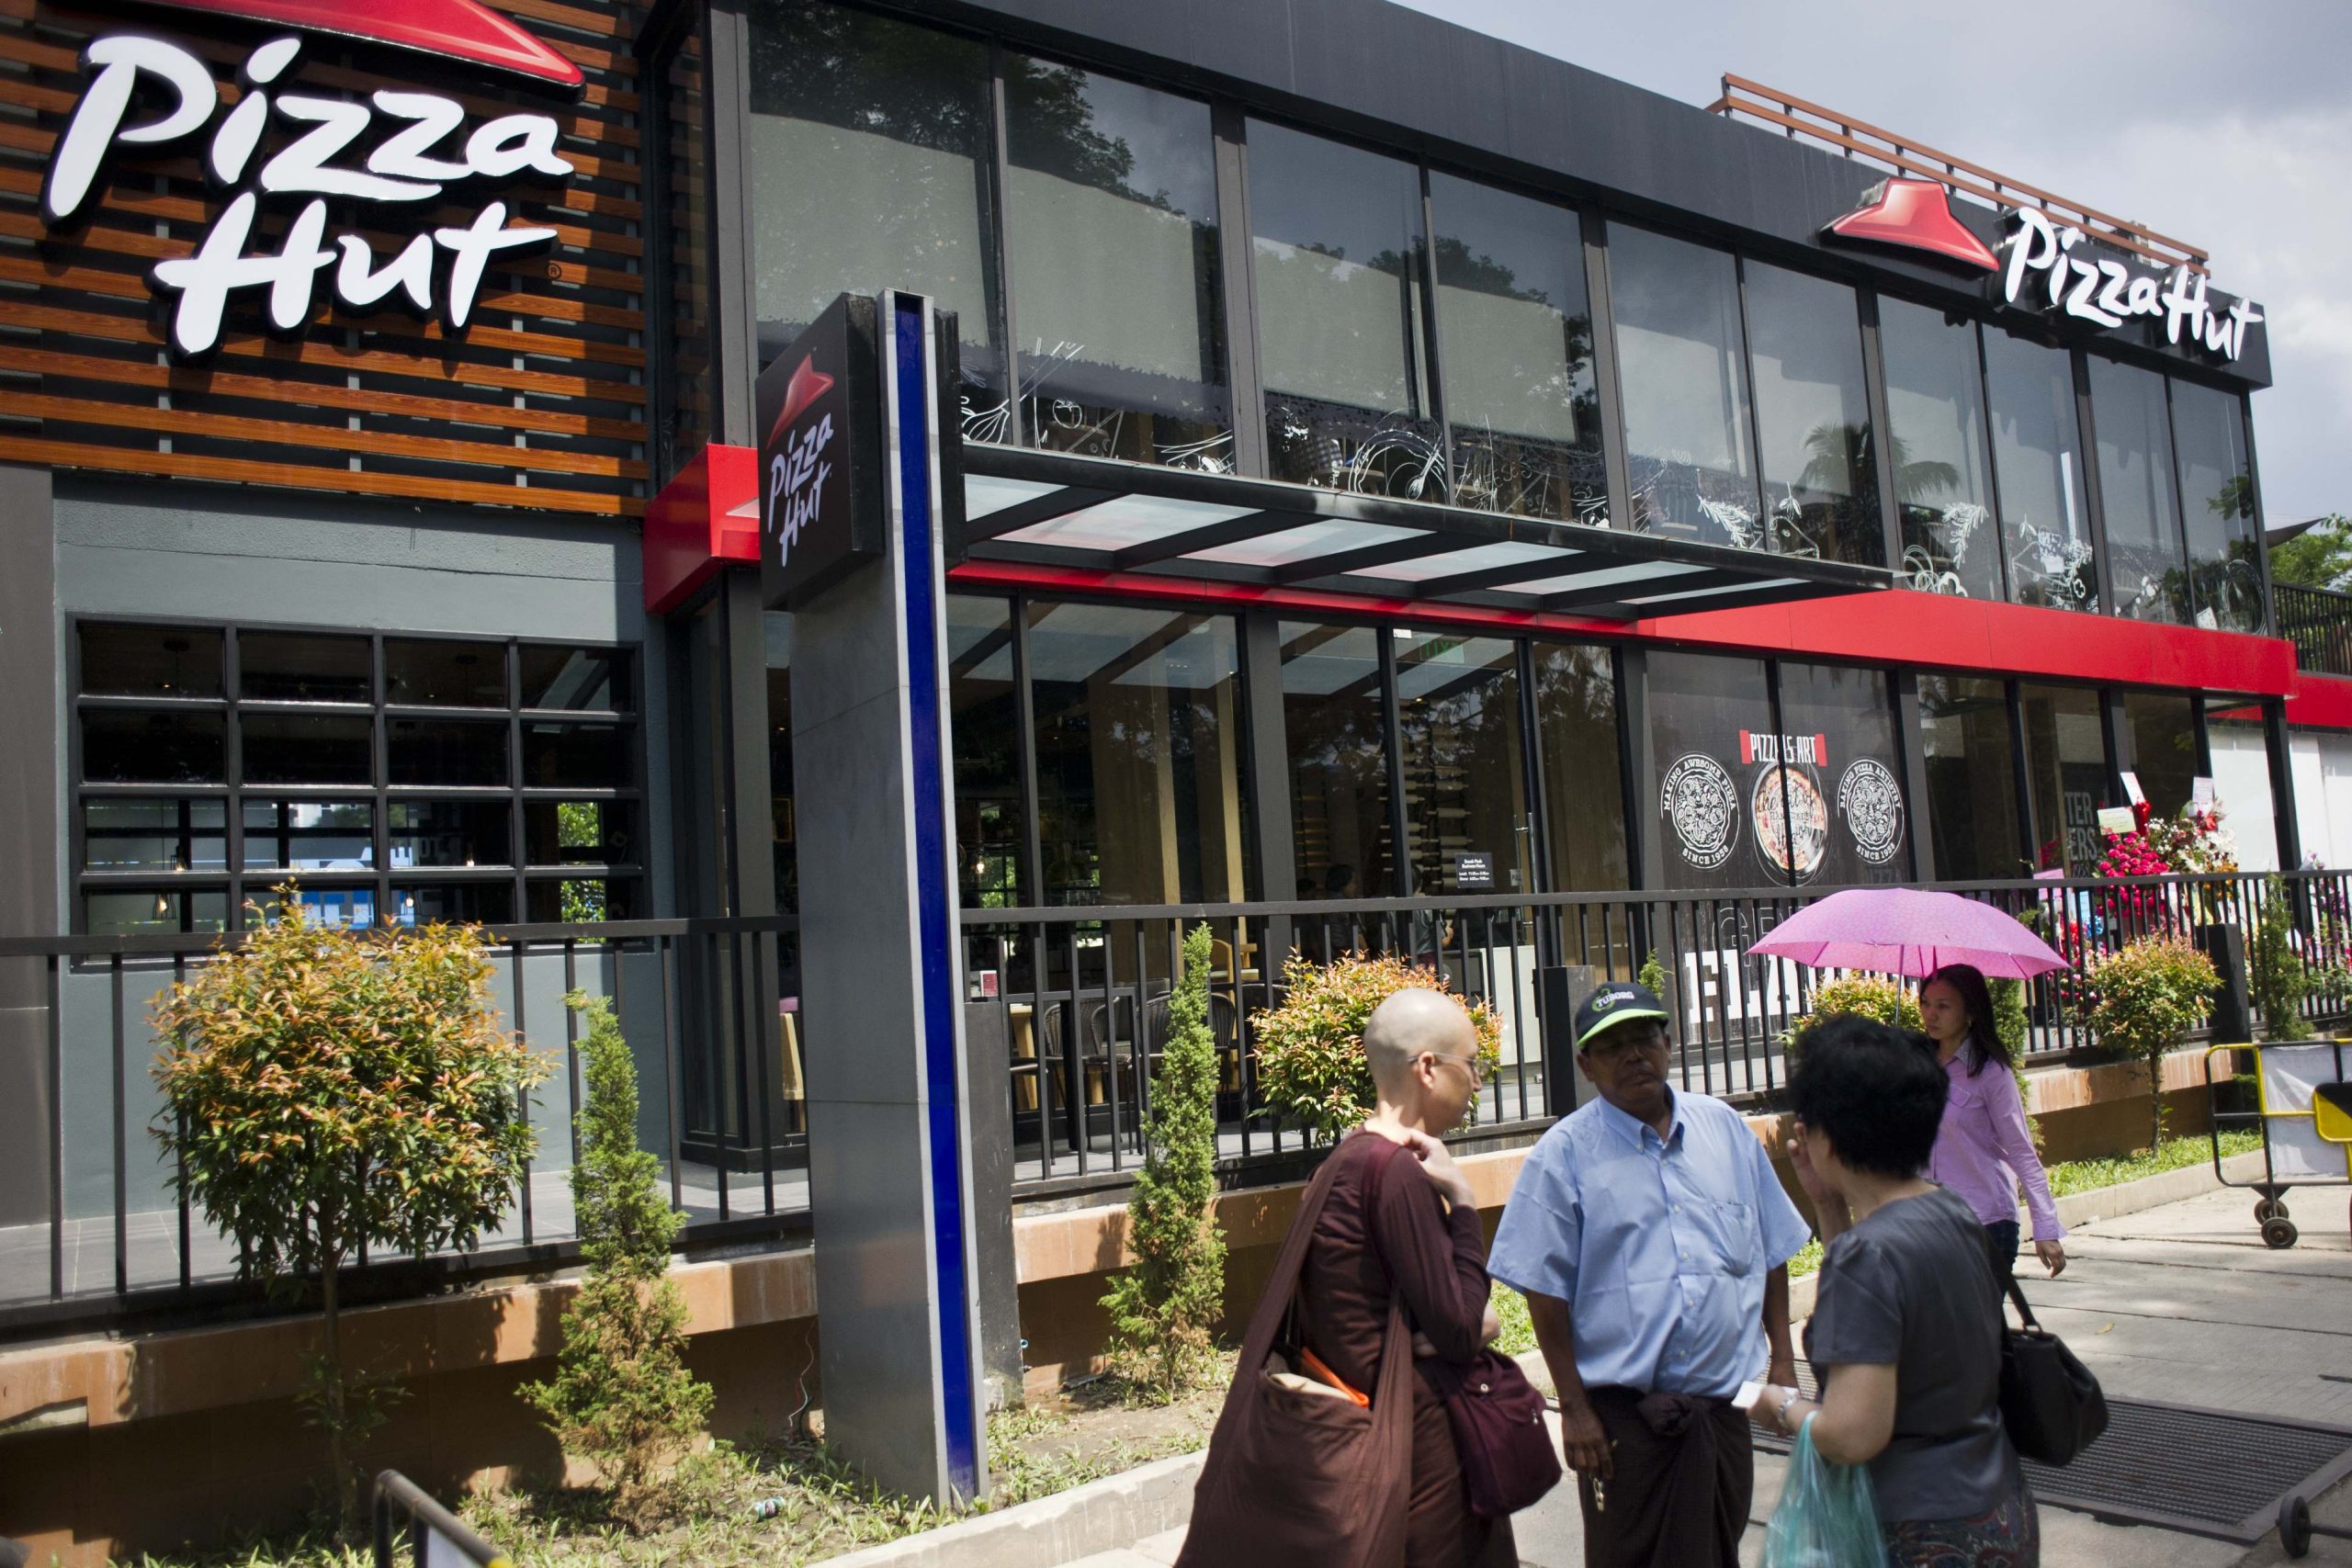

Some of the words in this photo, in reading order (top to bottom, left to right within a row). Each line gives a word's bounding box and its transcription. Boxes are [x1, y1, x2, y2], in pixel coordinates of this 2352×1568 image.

[49, 36, 573, 220] Pizza
[153, 192, 558, 353] Hut
[2006, 207, 2163, 328] Pizza
[2160, 265, 2264, 360] Hut
[768, 412, 834, 534] Pizza
[779, 460, 831, 567] Hut
[1795, 736, 1817, 763] ART
[1664, 767, 1682, 811] MAKING
[1683, 758, 1722, 778] AWESOME
[1722, 777, 1736, 811] PIZZA
[1853, 762, 1874, 774] PIZZA
[1875, 766, 1902, 808] ARTISTRY
[2064, 791, 2095, 825] TER
[1682, 847, 1710, 864] SINCE
[1856, 844, 1880, 861] SINCE
[2068, 826, 2099, 862] ERS
[1597, 991, 1634, 1007] TUBORG
